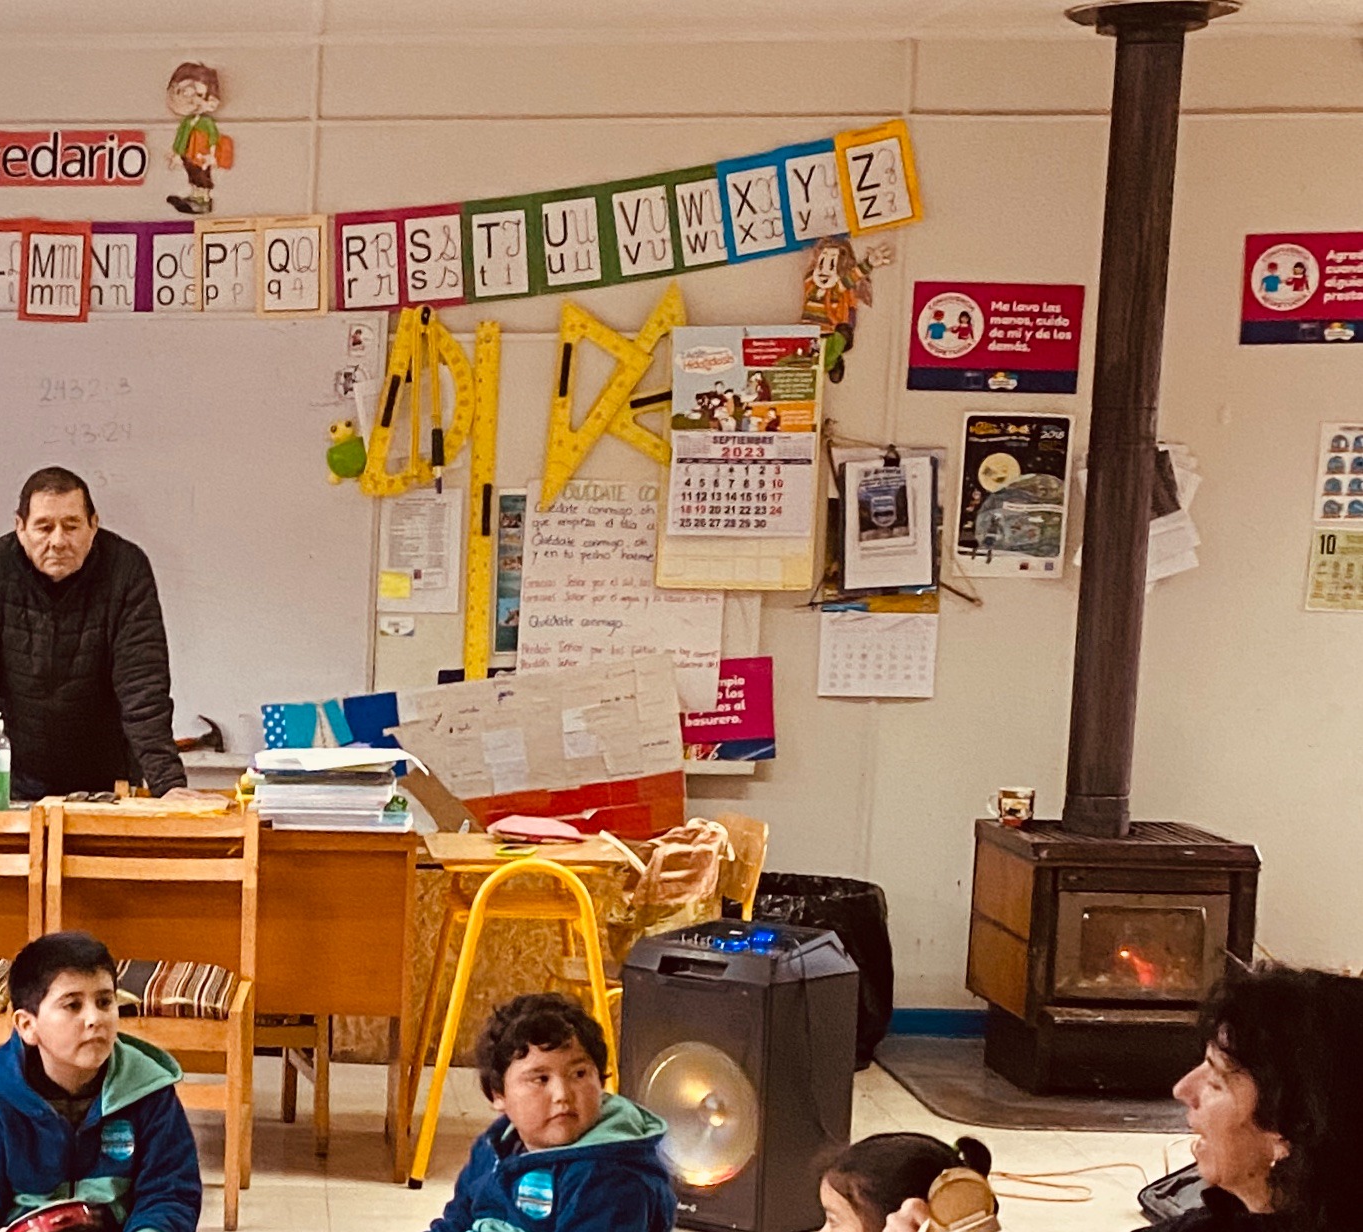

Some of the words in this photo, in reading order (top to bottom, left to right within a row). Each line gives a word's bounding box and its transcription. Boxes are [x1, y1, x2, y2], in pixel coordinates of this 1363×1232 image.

[852, 152, 880, 192] Z
[793, 164, 816, 203] Y
[680, 191, 703, 228] W
[732, 180, 757, 218] X
[859, 194, 882, 220] z
[619, 198, 641, 236] V
[798, 209, 811, 231] y
[545, 210, 568, 248] U
[739, 222, 757, 244] x
[409, 229, 432, 263] S
[477, 222, 500, 259] T
[686, 231, 708, 254] w
[32, 243, 56, 278] M
[205, 243, 228, 278] P
[268, 238, 290, 274] Q
[346, 235, 369, 272] R
[548, 252, 565, 274] u
[623, 242, 642, 265] v
[411, 270, 428, 290] s
[479, 265, 488, 286] t
[30, 284, 54, 304] m
[205, 284, 219, 305] p
[267, 279, 282, 300] q
[347, 277, 358, 299] r
[991, 301, 1010, 311] Me
[1012, 300, 1040, 312] lavo
[1042, 301, 1061, 313] las
[990, 316, 1034, 327] manos,
[988, 327, 1005, 338] de
[1024, 330, 1034, 342] y
[1035, 327, 1050, 339] de
[1053, 328, 1072, 340] los
[712, 435, 774, 445] SEPTIEMBRE
[721, 446, 765, 458] 2023
[744, 465, 749, 475] 1
[759, 465, 766, 475] 2
[774, 465, 781, 475] 3
[684, 478, 691, 488] 4
[699, 478, 705, 488] 5
[713, 478, 720, 488] 6
[728, 478, 735, 488] 7
[758, 478, 765, 488] 9
[772, 478, 784, 488] 10
[681, 492, 693, 502] 11
[695, 492, 708, 502] 12
[711, 492, 722, 502] 13
[725, 492, 738, 502] 14
[770, 492, 783, 502] 17
[695, 505, 707, 515] 19
[708, 505, 722, 515] 20
[724, 505, 736, 515] 21
[739, 505, 752, 515] 22
[754, 505, 767, 515] 23
[769, 505, 783, 515] 24
[708, 518, 721, 528] 27
[753, 518, 767, 528] 30
[1319, 534, 1337, 555] 10
[725, 688, 744, 699] los
[733, 699, 746, 710] al
[684, 712, 743, 727] basurero.
